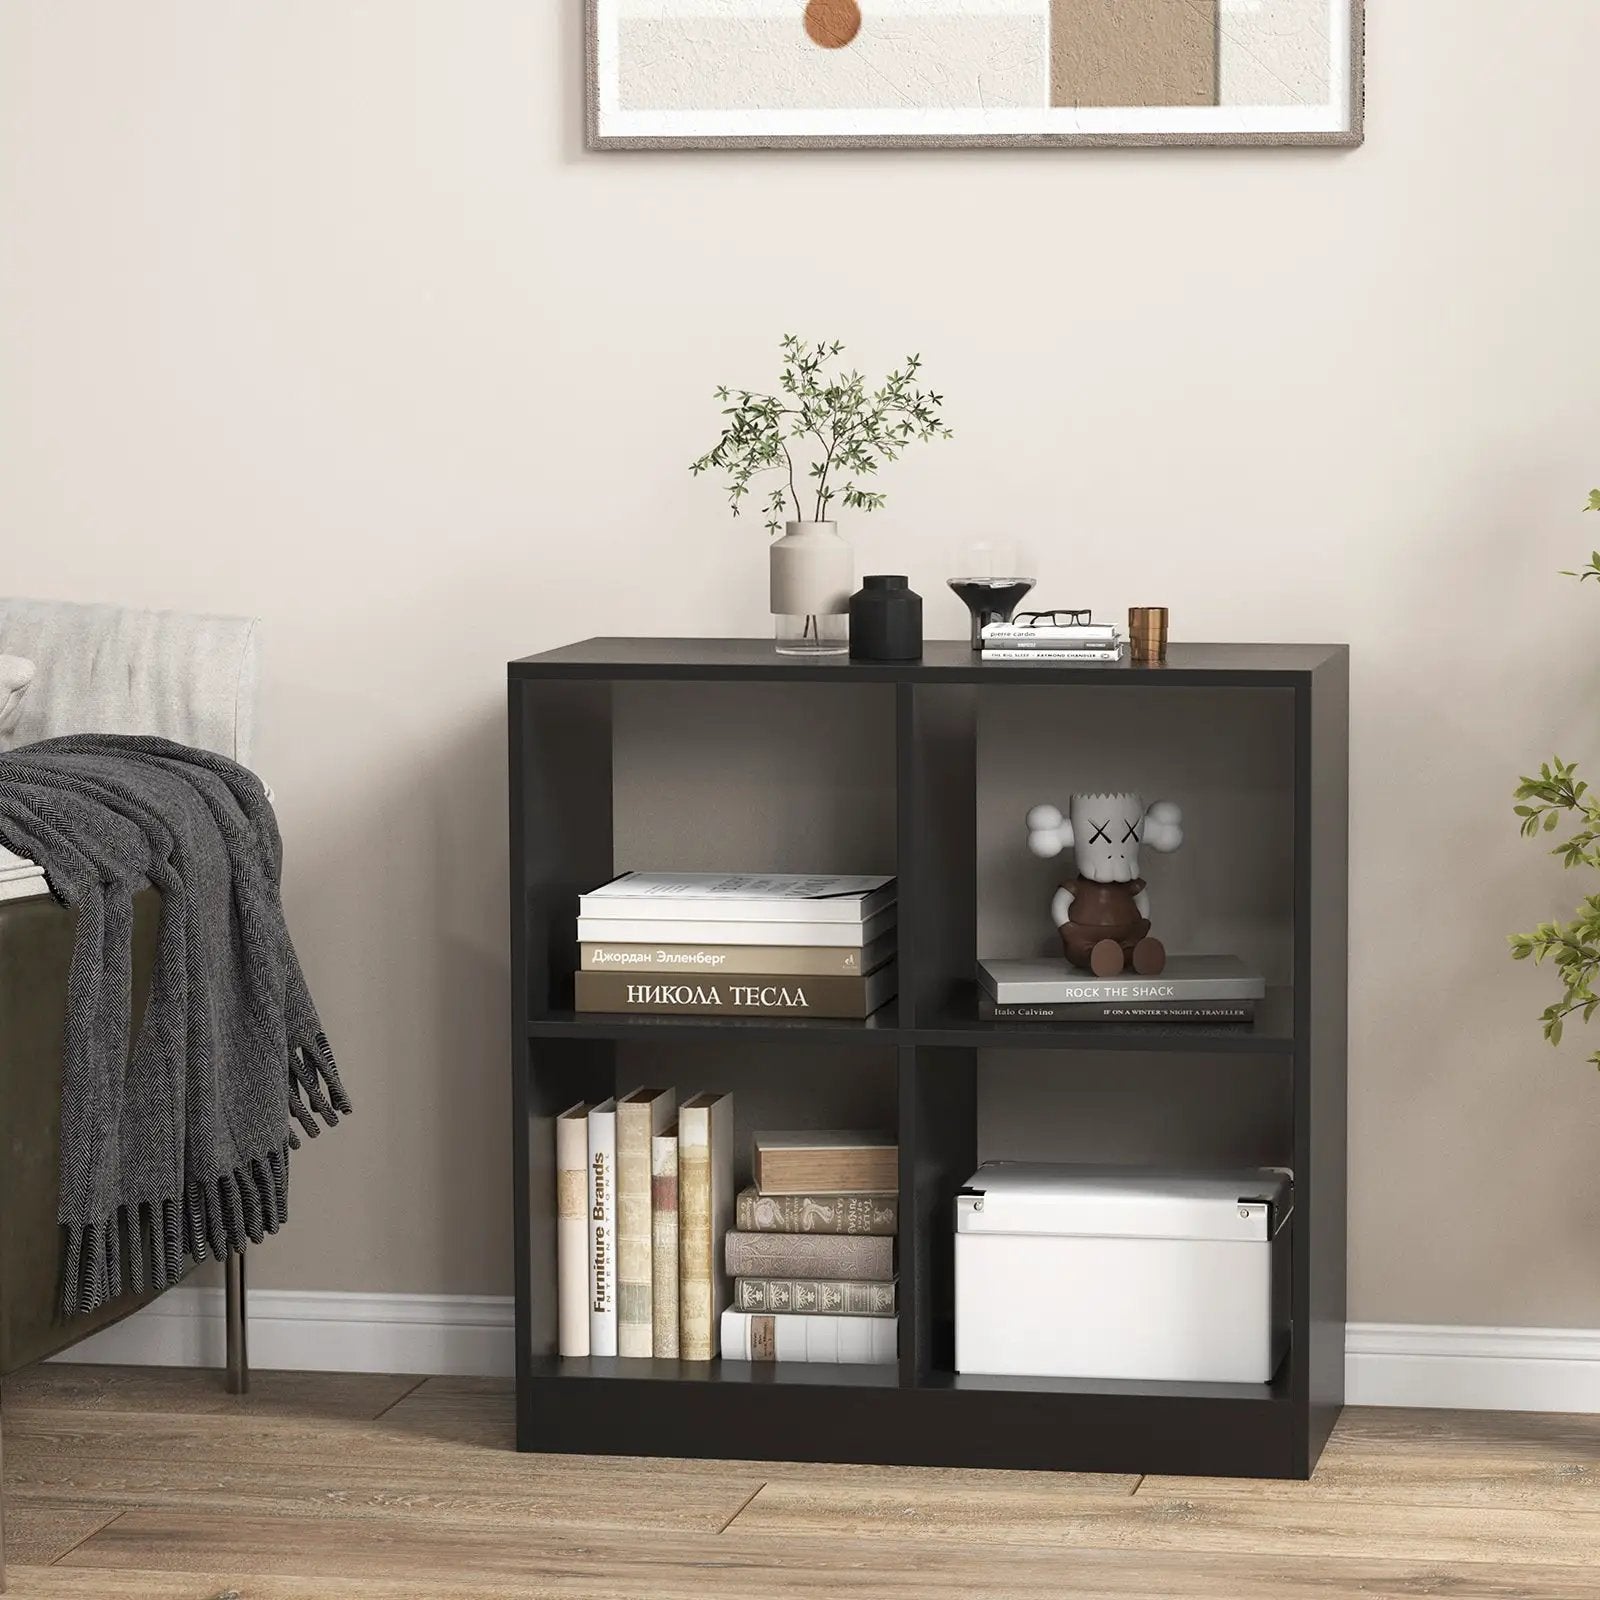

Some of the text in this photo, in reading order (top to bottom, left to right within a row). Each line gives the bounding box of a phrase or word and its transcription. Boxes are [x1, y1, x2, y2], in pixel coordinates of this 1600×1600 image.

[592, 949, 726, 966] Джордан Элленберг
[626, 984, 810, 1007] НИКОЛА ТЕСЛА
[1065, 986, 1174, 998] ROCK THE SHACK
[994, 1008, 1054, 1016] Italo Calvino
[592, 1151, 605, 1313] Furniture Brands
